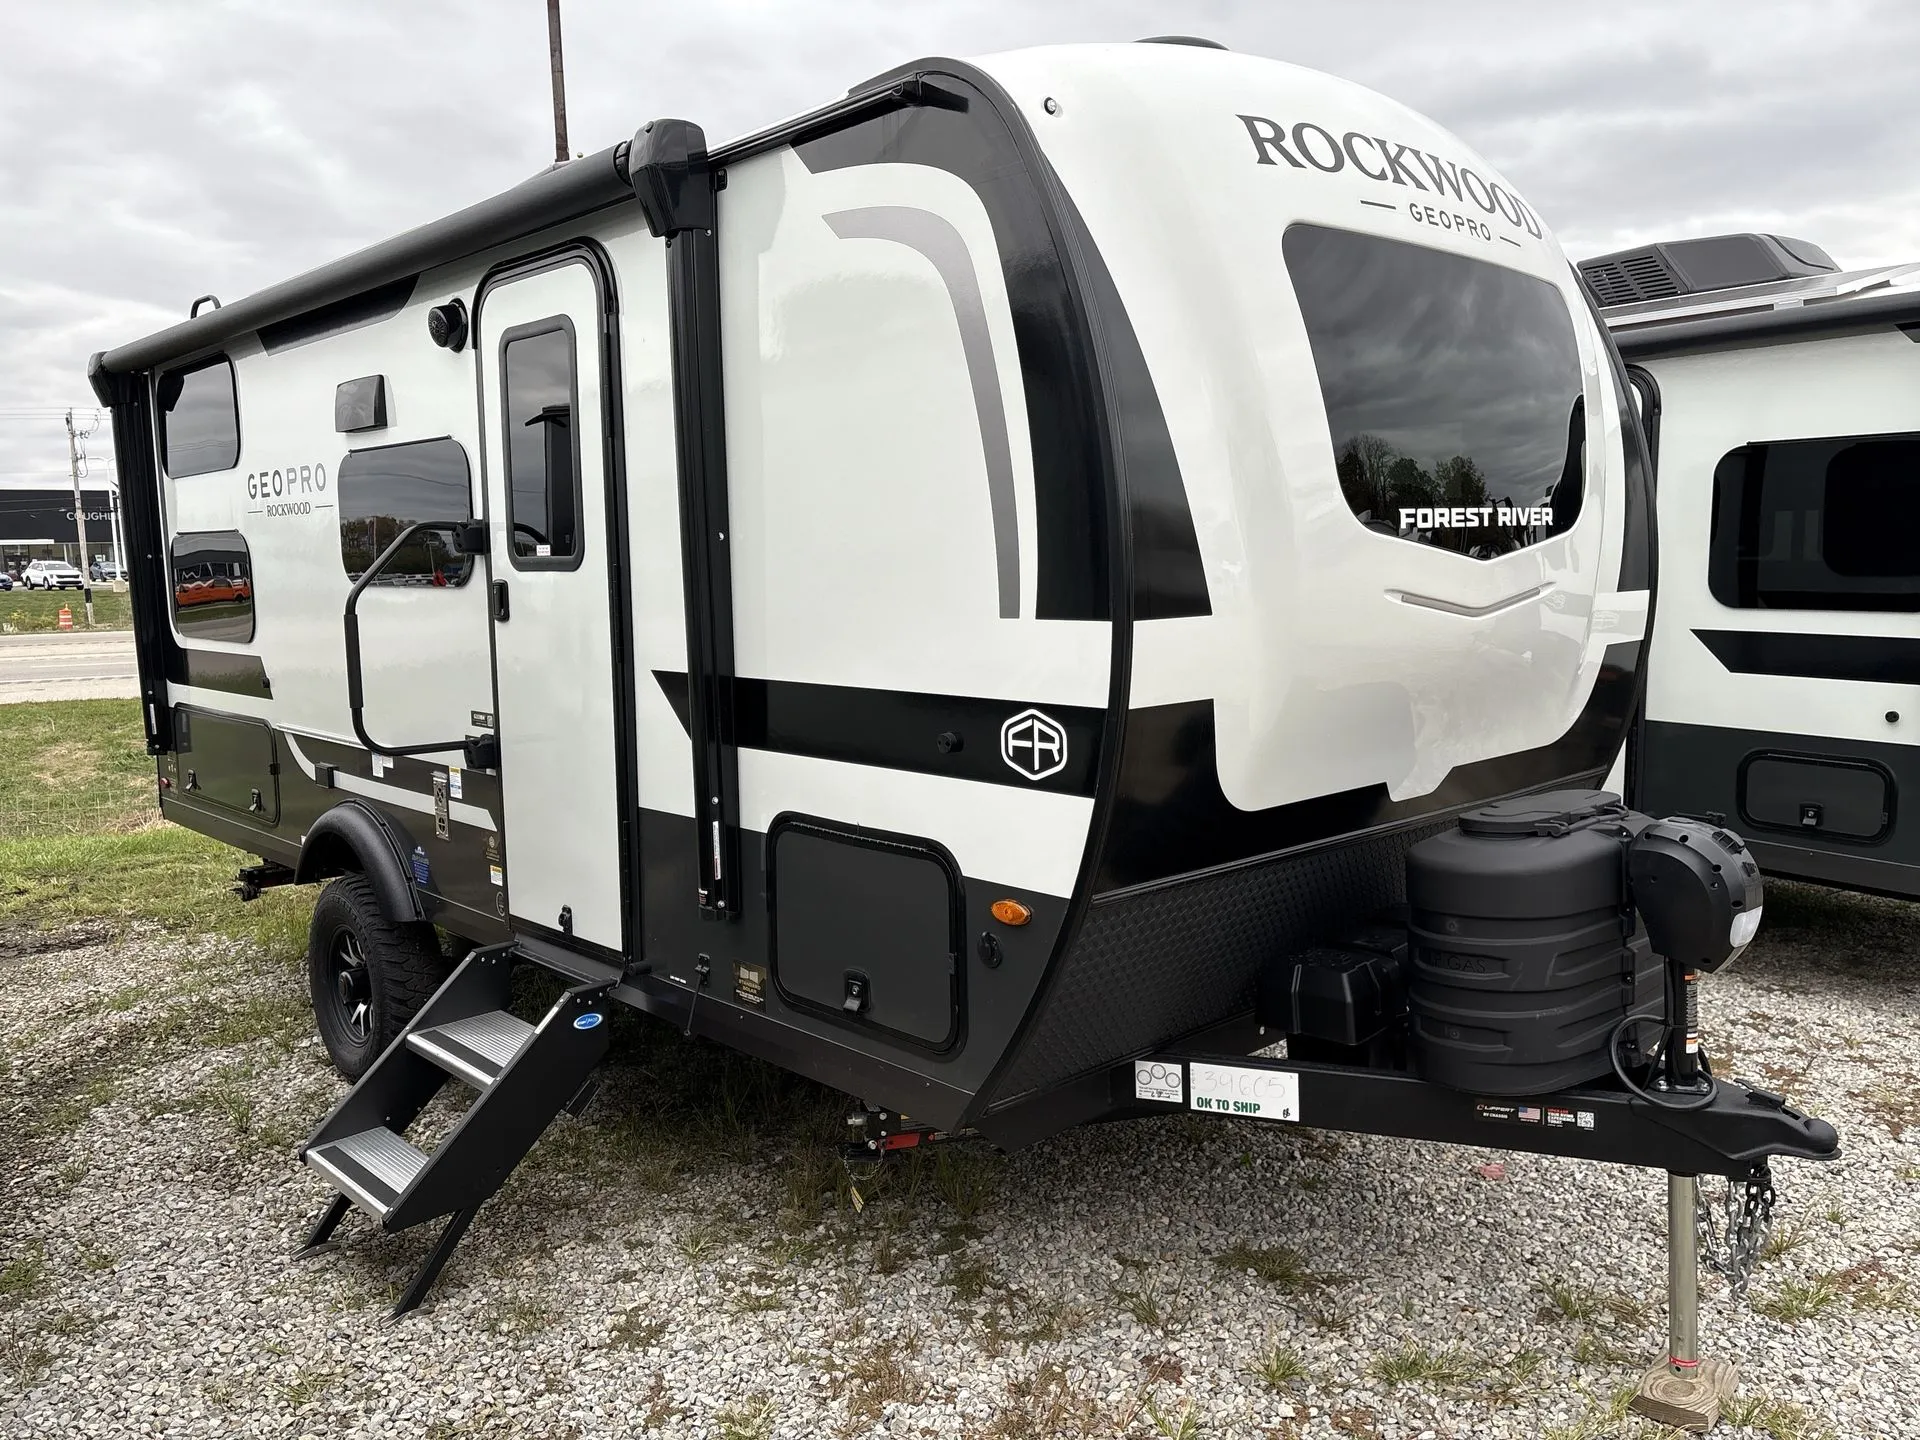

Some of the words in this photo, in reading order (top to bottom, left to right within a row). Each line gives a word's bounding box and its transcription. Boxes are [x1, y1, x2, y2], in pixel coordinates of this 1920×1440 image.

[1235, 113, 1543, 241] ROCKWOOD
[1409, 202, 1491, 242] GEOPRO
[247, 462, 327, 499] GEOPRO
[266, 501, 312, 517] ROCKWOOD
[1398, 507, 1493, 529] FOREST
[1496, 507, 1553, 527] RIVER
[1196, 1096, 1213, 1109] OK
[1215, 1098, 1230, 1111] TO
[1233, 1100, 1261, 1114] SHIP
